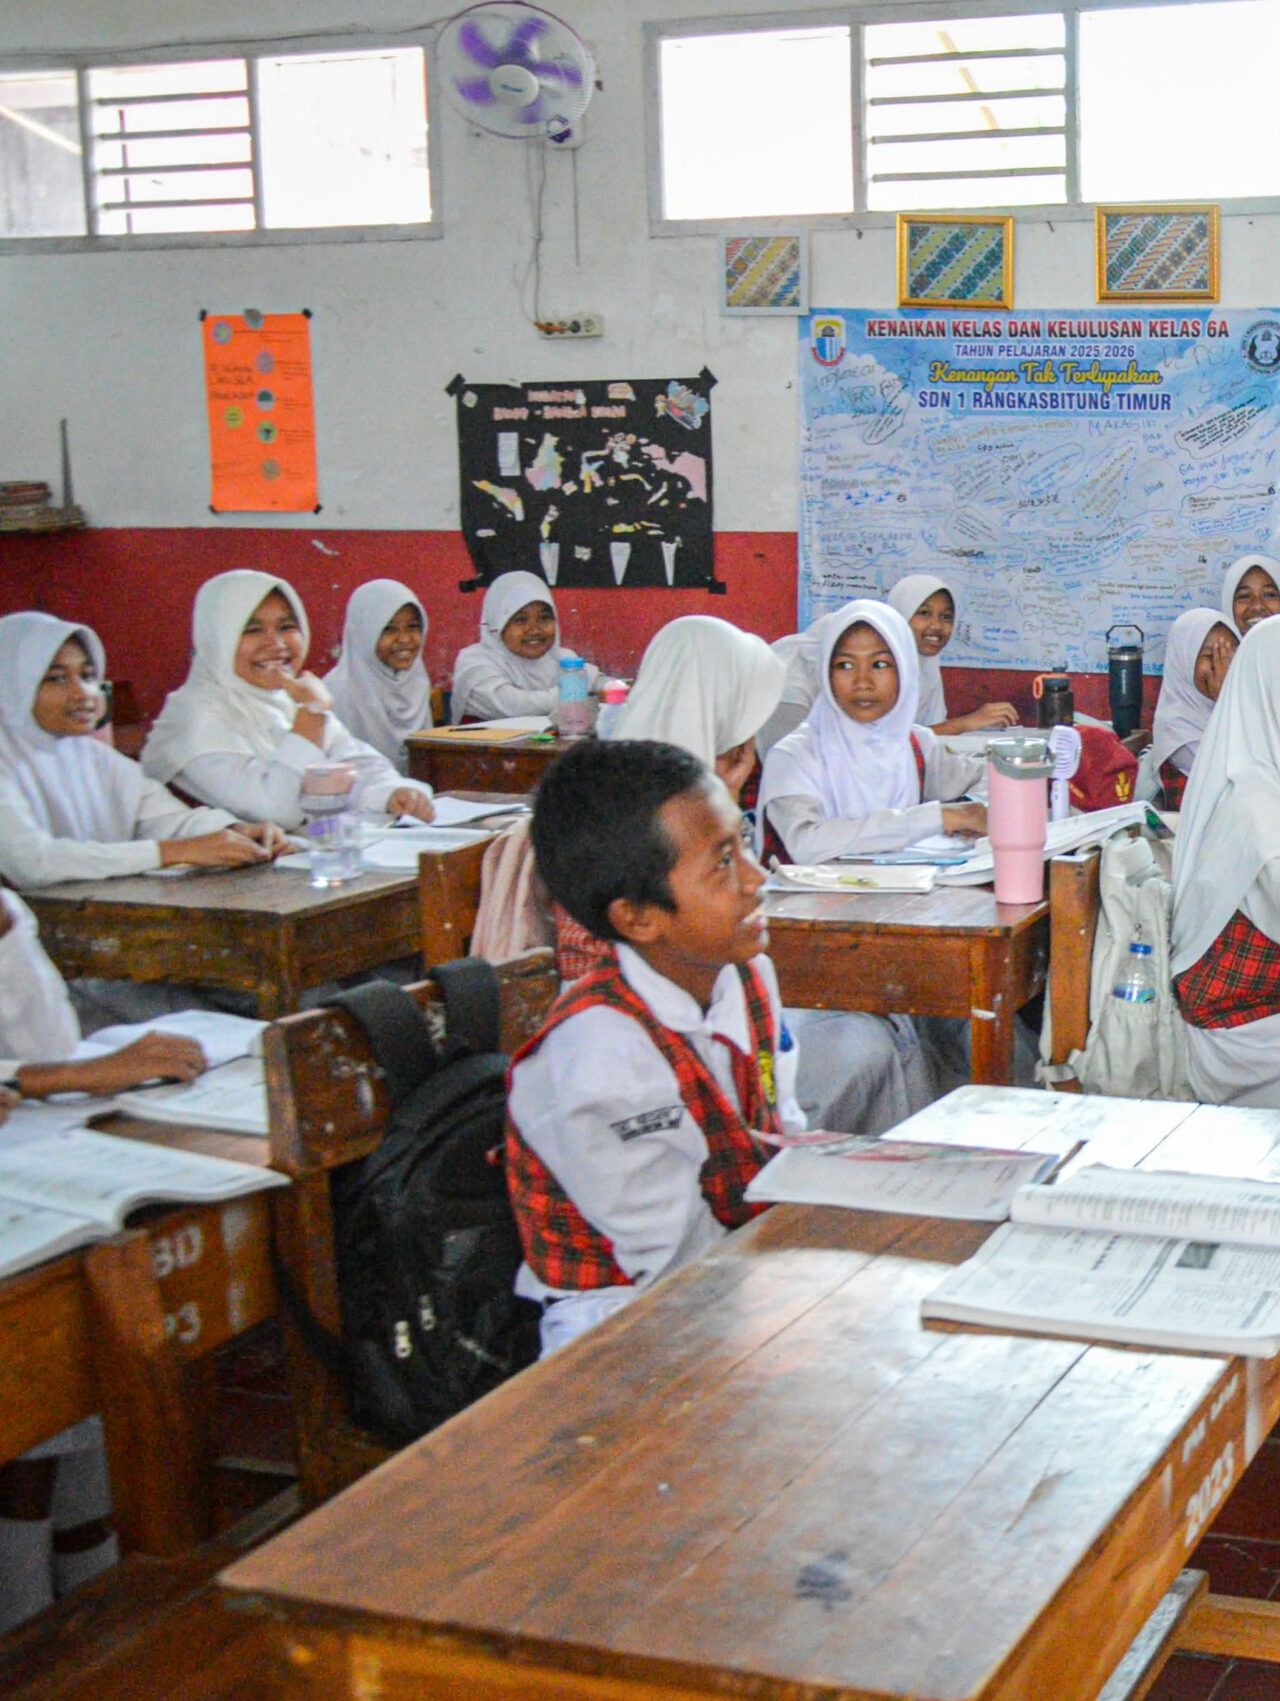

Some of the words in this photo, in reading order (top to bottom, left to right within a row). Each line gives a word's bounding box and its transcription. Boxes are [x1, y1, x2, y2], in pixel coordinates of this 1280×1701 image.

[866, 319, 947, 338] KENAIKAN
[952, 319, 1004, 338] KELAS
[1008, 320, 1041, 338] DAN
[1047, 320, 1143, 338] KELULUSAN
[1148, 320, 1202, 338] KELAS
[1207, 320, 1229, 338] 6A
[955, 344, 994, 358] TAHUN
[997, 344, 1067, 358] PELAJARAN
[1070, 344, 1135, 358] 2025/2026
[929, 361, 1017, 391] Kenangan
[1020, 361, 1057, 384] Tak
[1059, 361, 1163, 391] Terlupakan
[919, 392, 951, 409] SDN
[958, 392, 965, 409] 1
[973, 392, 1110, 411] RANGKASBITUNG
[1118, 392, 1171, 411] TIMUR
[1184, 1441, 1234, 1547] 2023
